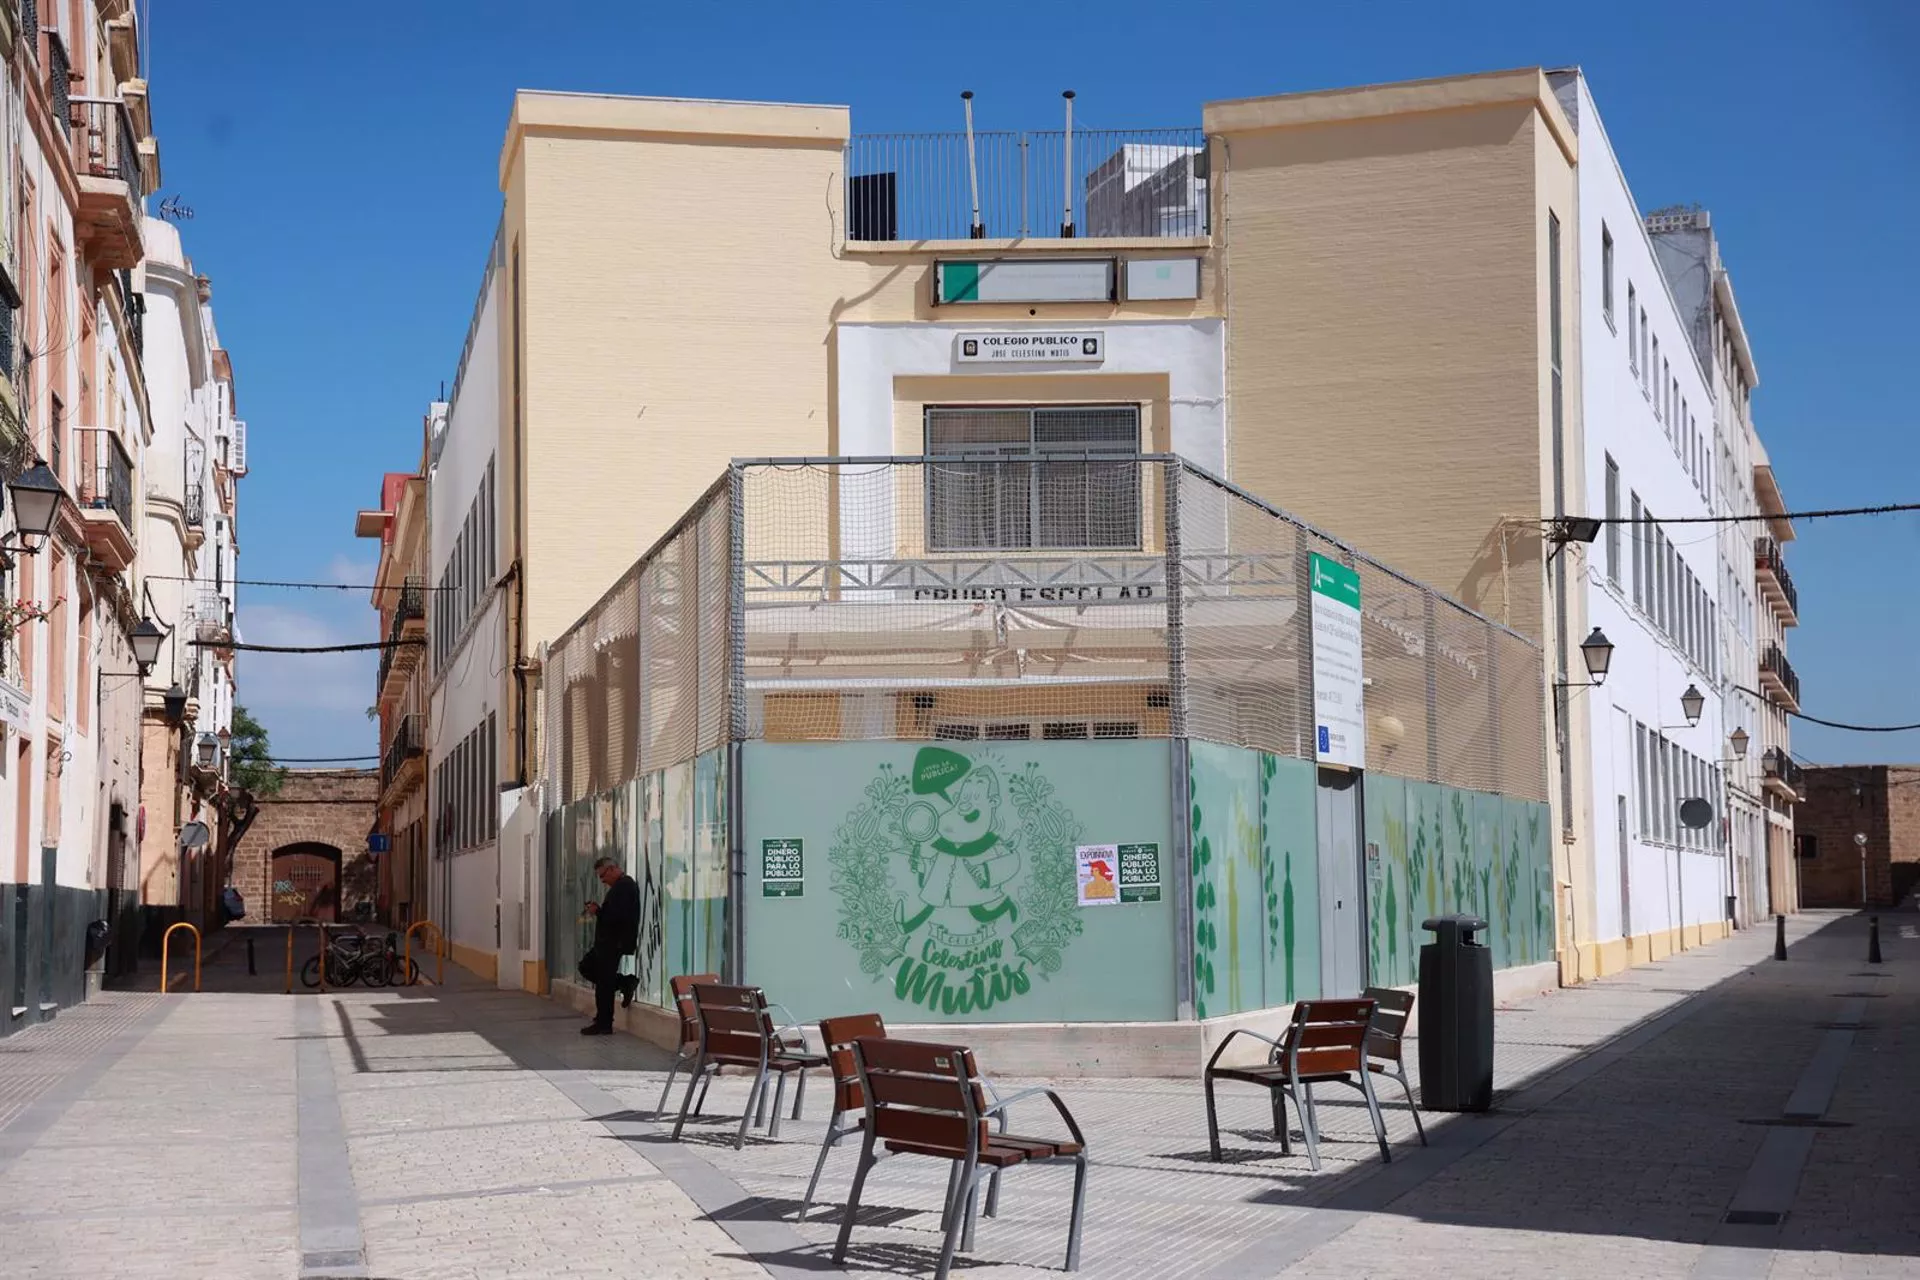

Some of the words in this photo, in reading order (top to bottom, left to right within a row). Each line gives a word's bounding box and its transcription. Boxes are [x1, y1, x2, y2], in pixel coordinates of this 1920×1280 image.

[983, 337, 1029, 346] COLEGIO
[1032, 336, 1078, 345] PUBLICO
[765, 854, 801, 862] PÚBLICO
[1121, 860, 1157, 868] PÚBLICO
[765, 869, 801, 877] PÚBLICO
[1122, 874, 1158, 883] PÚBLICO
[921, 939, 1003, 971] Celestino
[895, 956, 1031, 1015] Mutis
